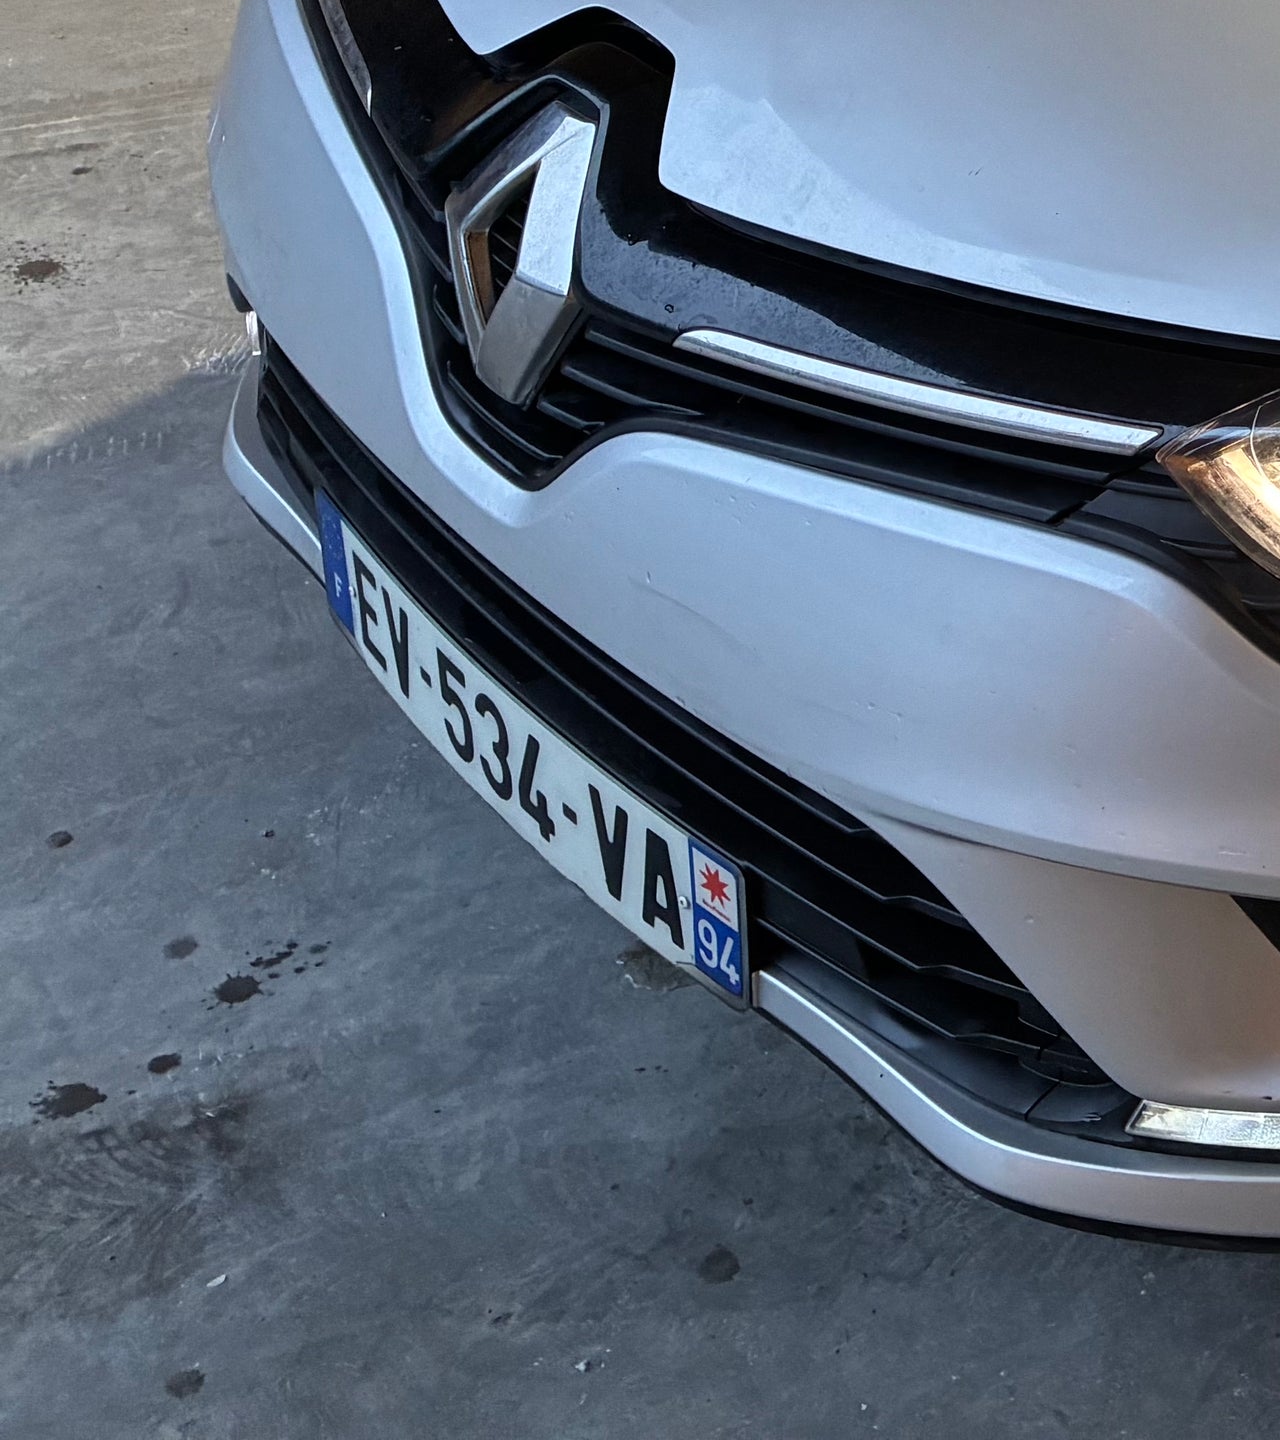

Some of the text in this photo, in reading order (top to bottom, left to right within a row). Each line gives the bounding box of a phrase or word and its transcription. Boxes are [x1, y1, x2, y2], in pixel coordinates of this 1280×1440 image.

[334, 571, 343, 598] F
[352, 549, 685, 951] EV-534-VA
[698, 918, 741, 986] 94
